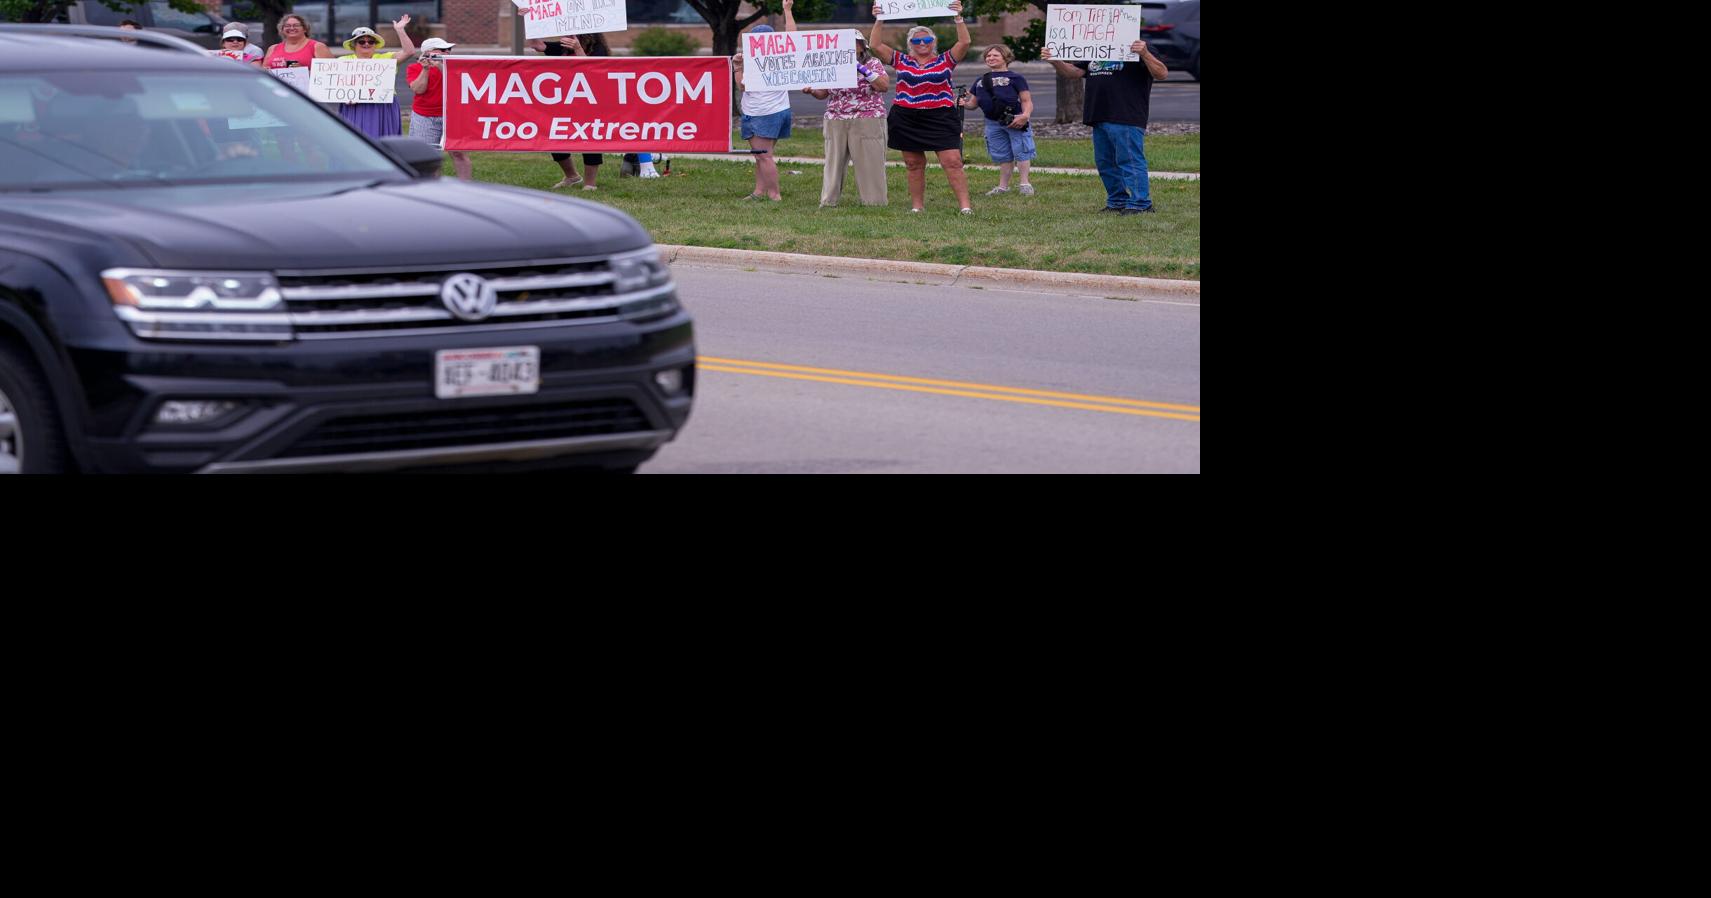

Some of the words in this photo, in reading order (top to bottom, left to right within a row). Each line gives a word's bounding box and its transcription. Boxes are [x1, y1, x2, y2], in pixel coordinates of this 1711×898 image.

[529, 2, 562, 20] MAGA
[555, 14, 606, 32] MIND
[1071, 23, 1115, 42] MAGA
[749, 34, 797, 57] MAGA
[802, 33, 839, 51] TOM
[1046, 41, 1116, 59] Extremist
[754, 54, 796, 72] VOTES
[801, 48, 856, 69] AGAINST
[761, 66, 838, 87] WISCONSIN
[460, 72, 598, 105] MAGA
[607, 71, 713, 105] TOM
[477, 116, 538, 140] Too
[549, 116, 698, 141] Extreme
